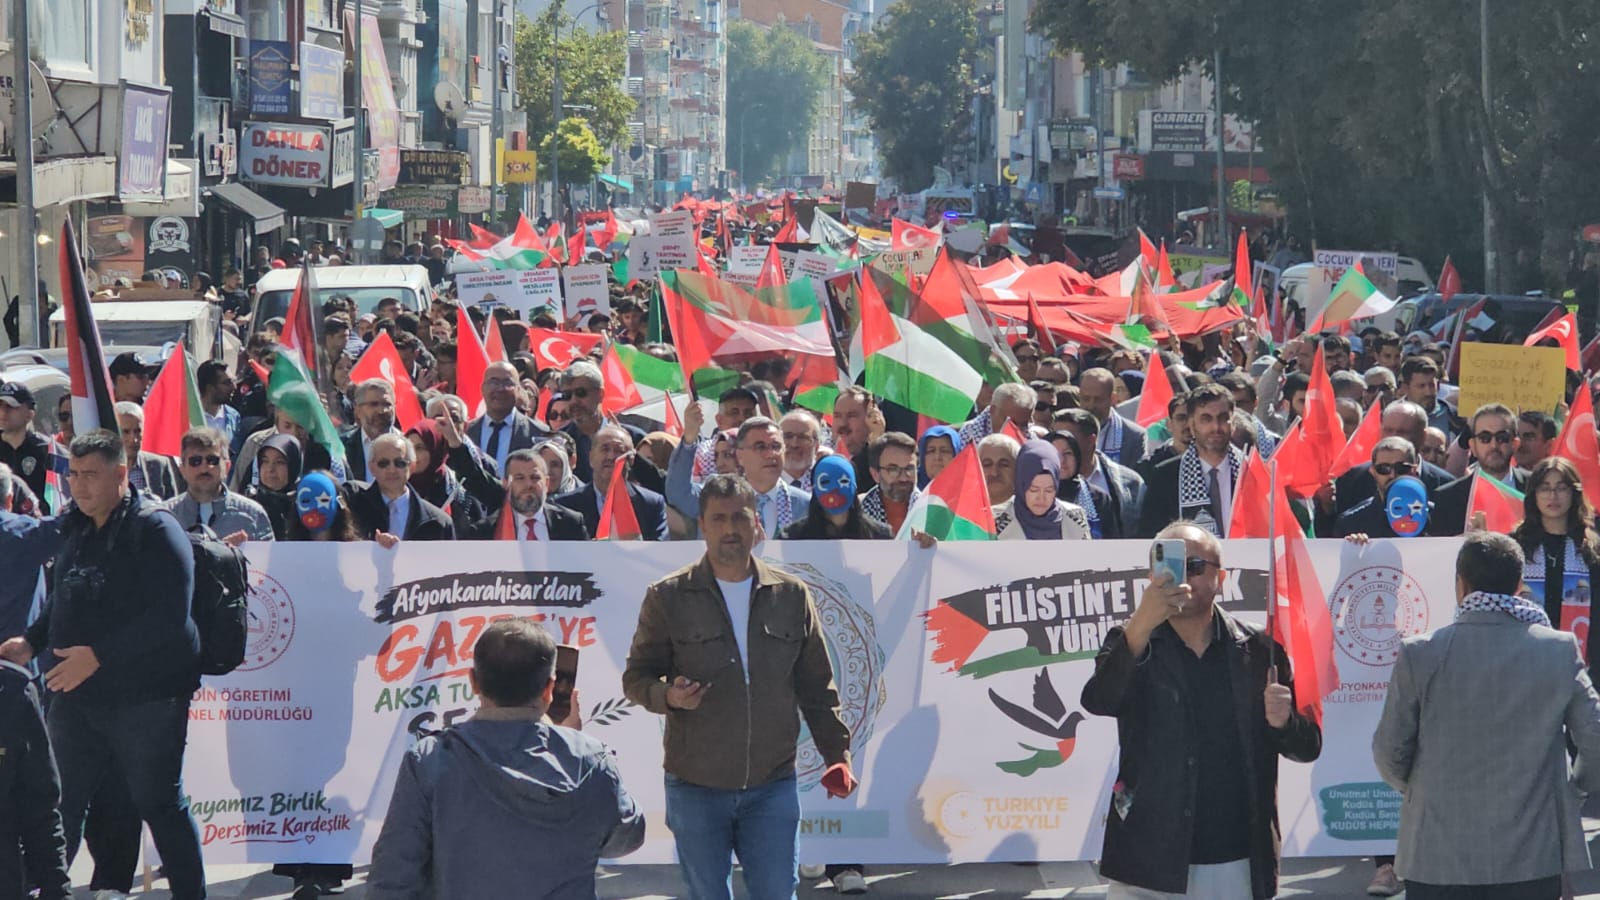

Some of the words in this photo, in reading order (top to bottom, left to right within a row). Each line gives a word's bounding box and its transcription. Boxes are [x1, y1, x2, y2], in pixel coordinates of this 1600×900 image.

[1153, 112, 1205, 123] CARMEN
[252, 129, 325, 151] DAMLA
[252, 154, 321, 179] DÖNER
[506, 159, 531, 175] ŞOK
[392, 576, 583, 616] Afyonkarahisar'dan
[985, 578, 1128, 626] FİLİSTİN'E
[375, 613, 597, 683] GAZ'YE
[221, 687, 291, 702] ÖĞRETİMİ
[374, 683, 441, 713] AKSA
[219, 706, 313, 721] MÜDÜRLÜĞÜ
[269, 790, 332, 817] Birlik,
[201, 819, 278, 846] Dersimiz
[281, 814, 352, 837] Kardeşlik
